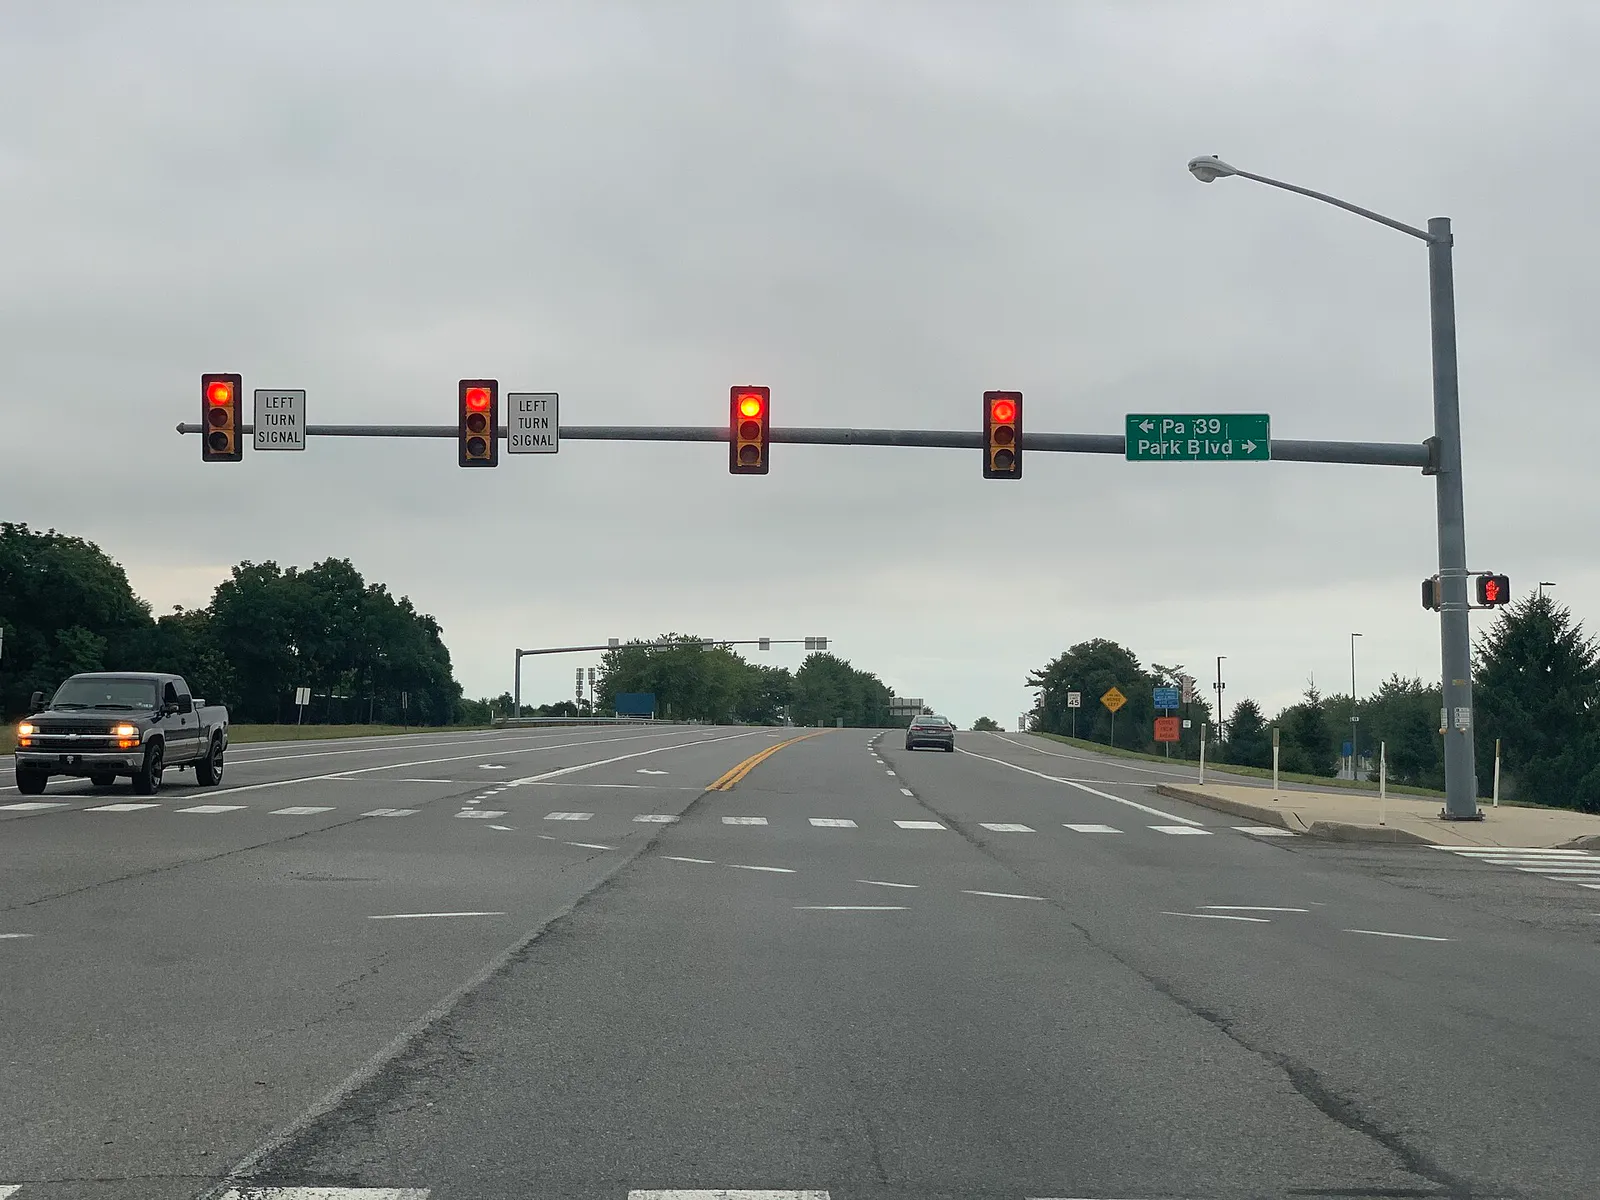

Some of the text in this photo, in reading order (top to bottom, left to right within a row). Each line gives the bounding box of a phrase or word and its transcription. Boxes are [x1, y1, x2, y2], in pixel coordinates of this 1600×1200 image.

[266, 396, 294, 409] LEFT
[519, 400, 547, 412] LEFT
[264, 413, 295, 426] TURN
[518, 417, 548, 429] TURN
[1162, 418, 1221, 434] Pa 39
[258, 431, 301, 443] SIGNAL
[512, 434, 554, 446] SIGNAL
[1138, 439, 1233, 455] Park Blvd
